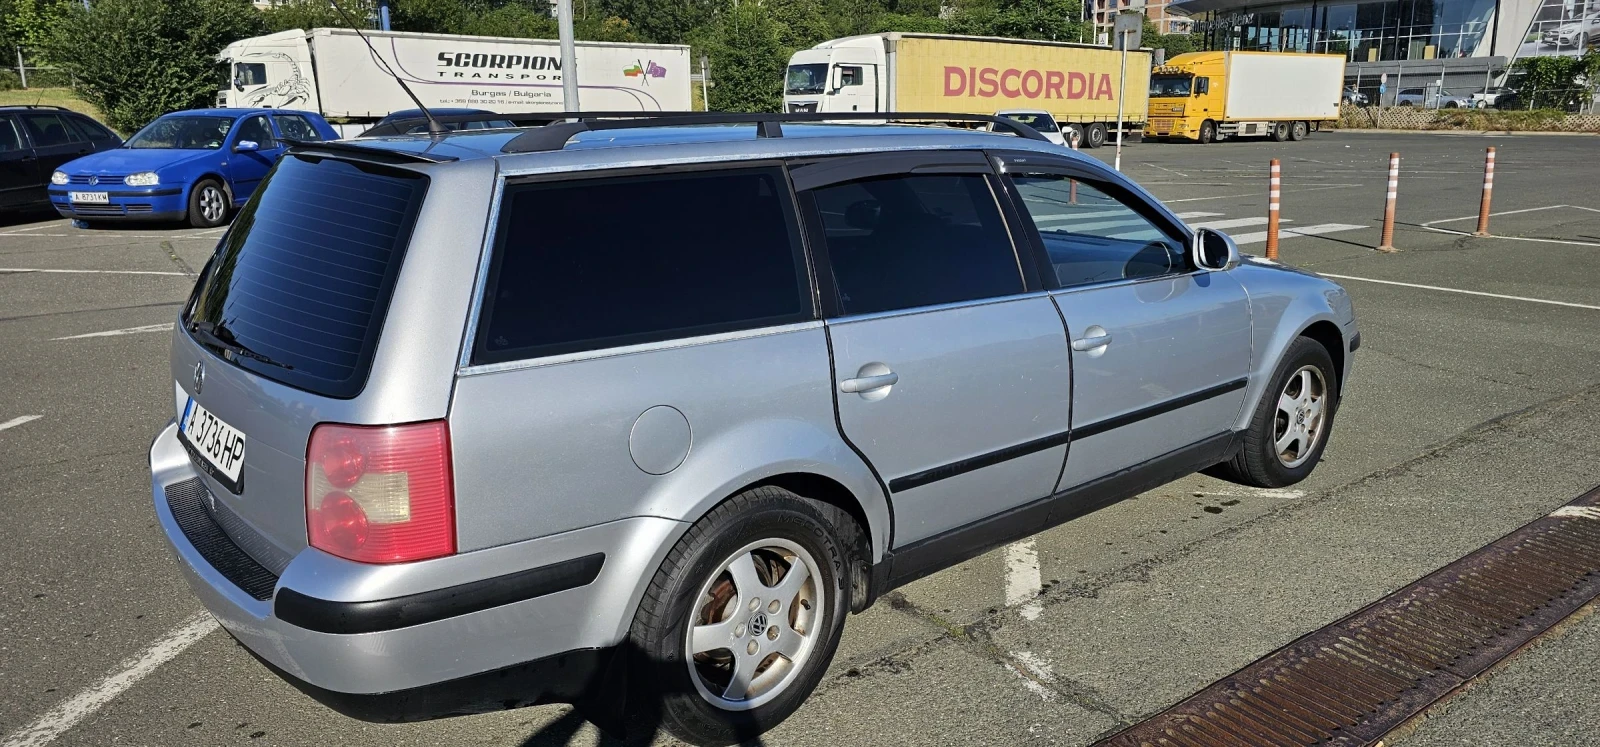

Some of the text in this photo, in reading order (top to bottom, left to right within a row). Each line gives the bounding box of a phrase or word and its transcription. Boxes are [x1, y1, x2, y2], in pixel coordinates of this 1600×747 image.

[437, 52, 578, 71] SCORPION
[437, 71, 562, 81] TRANSPOR
[943, 66, 1114, 100] DISCORDIA
[471, 89, 507, 98] Burgas
[513, 90, 552, 99] Bulgaria
[188, 403, 199, 434] A
[196, 410, 225, 459] 3736
[220, 430, 244, 471] HP
